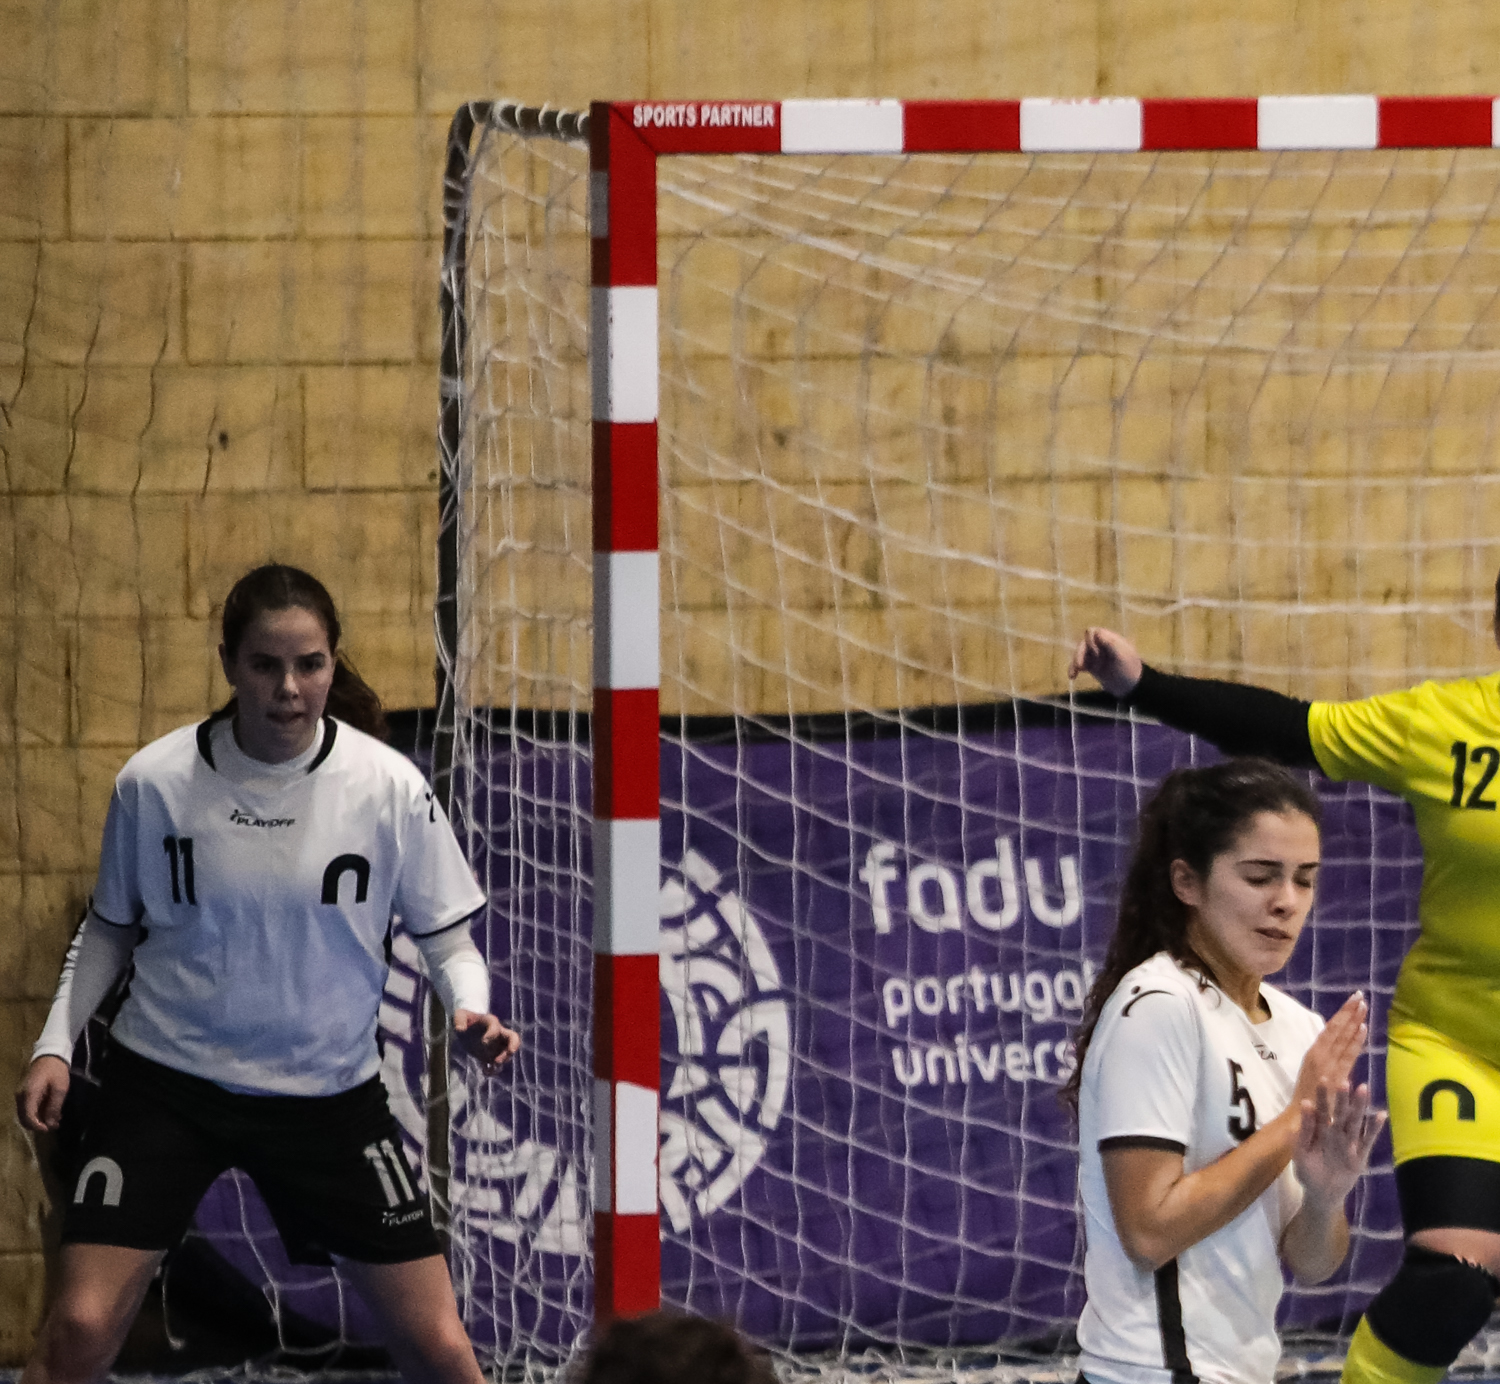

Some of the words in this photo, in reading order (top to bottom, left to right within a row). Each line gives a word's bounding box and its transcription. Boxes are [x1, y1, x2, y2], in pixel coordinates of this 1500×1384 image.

[632, 103, 698, 128] SPORTS
[700, 103, 775, 128] PARTNER
[1450, 740, 1500, 811] 12
[163, 835, 198, 905] 11
[858, 836, 1081, 934] fadu
[1226, 1058, 1257, 1142] 5
[363, 1138, 415, 1208] 11
